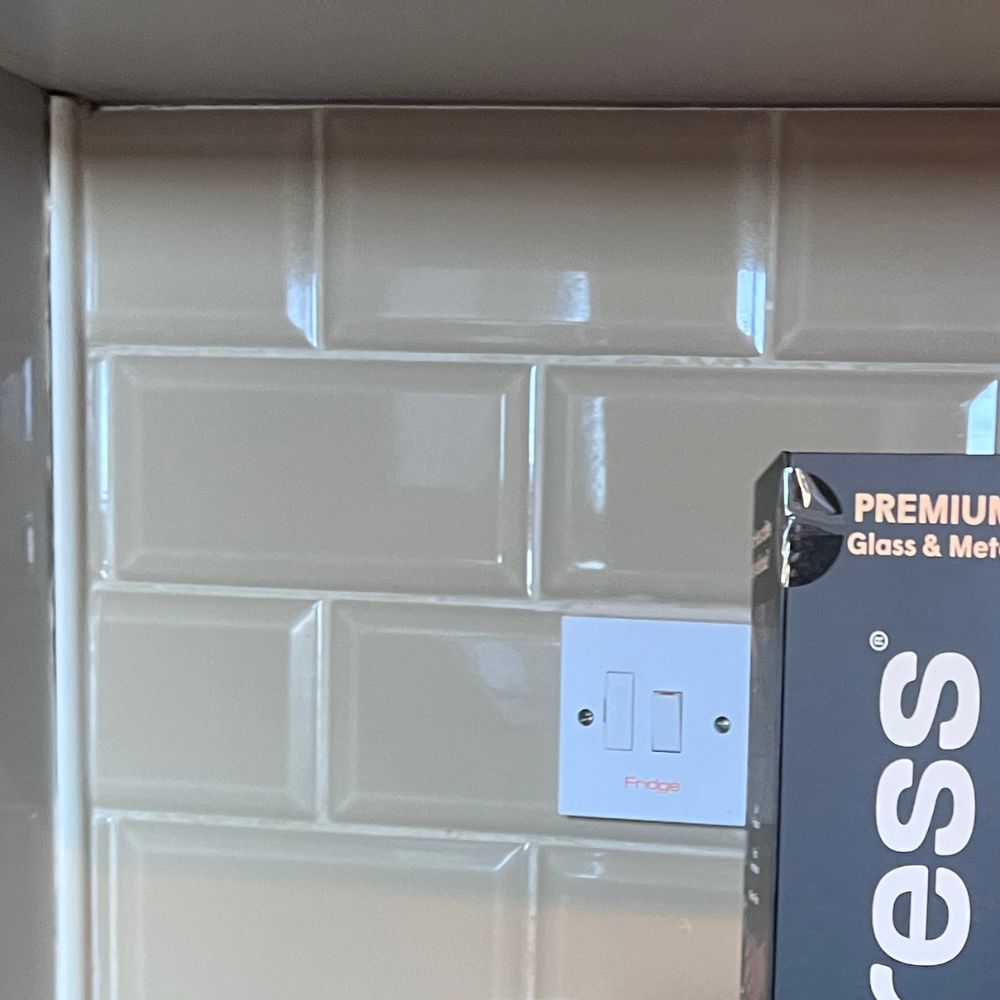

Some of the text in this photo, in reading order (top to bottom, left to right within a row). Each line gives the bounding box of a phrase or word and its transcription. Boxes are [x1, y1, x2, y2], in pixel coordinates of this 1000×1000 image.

[847, 532, 917, 556] Glass
[922, 534, 942, 557] &
[624, 776, 681, 794] Fridge
